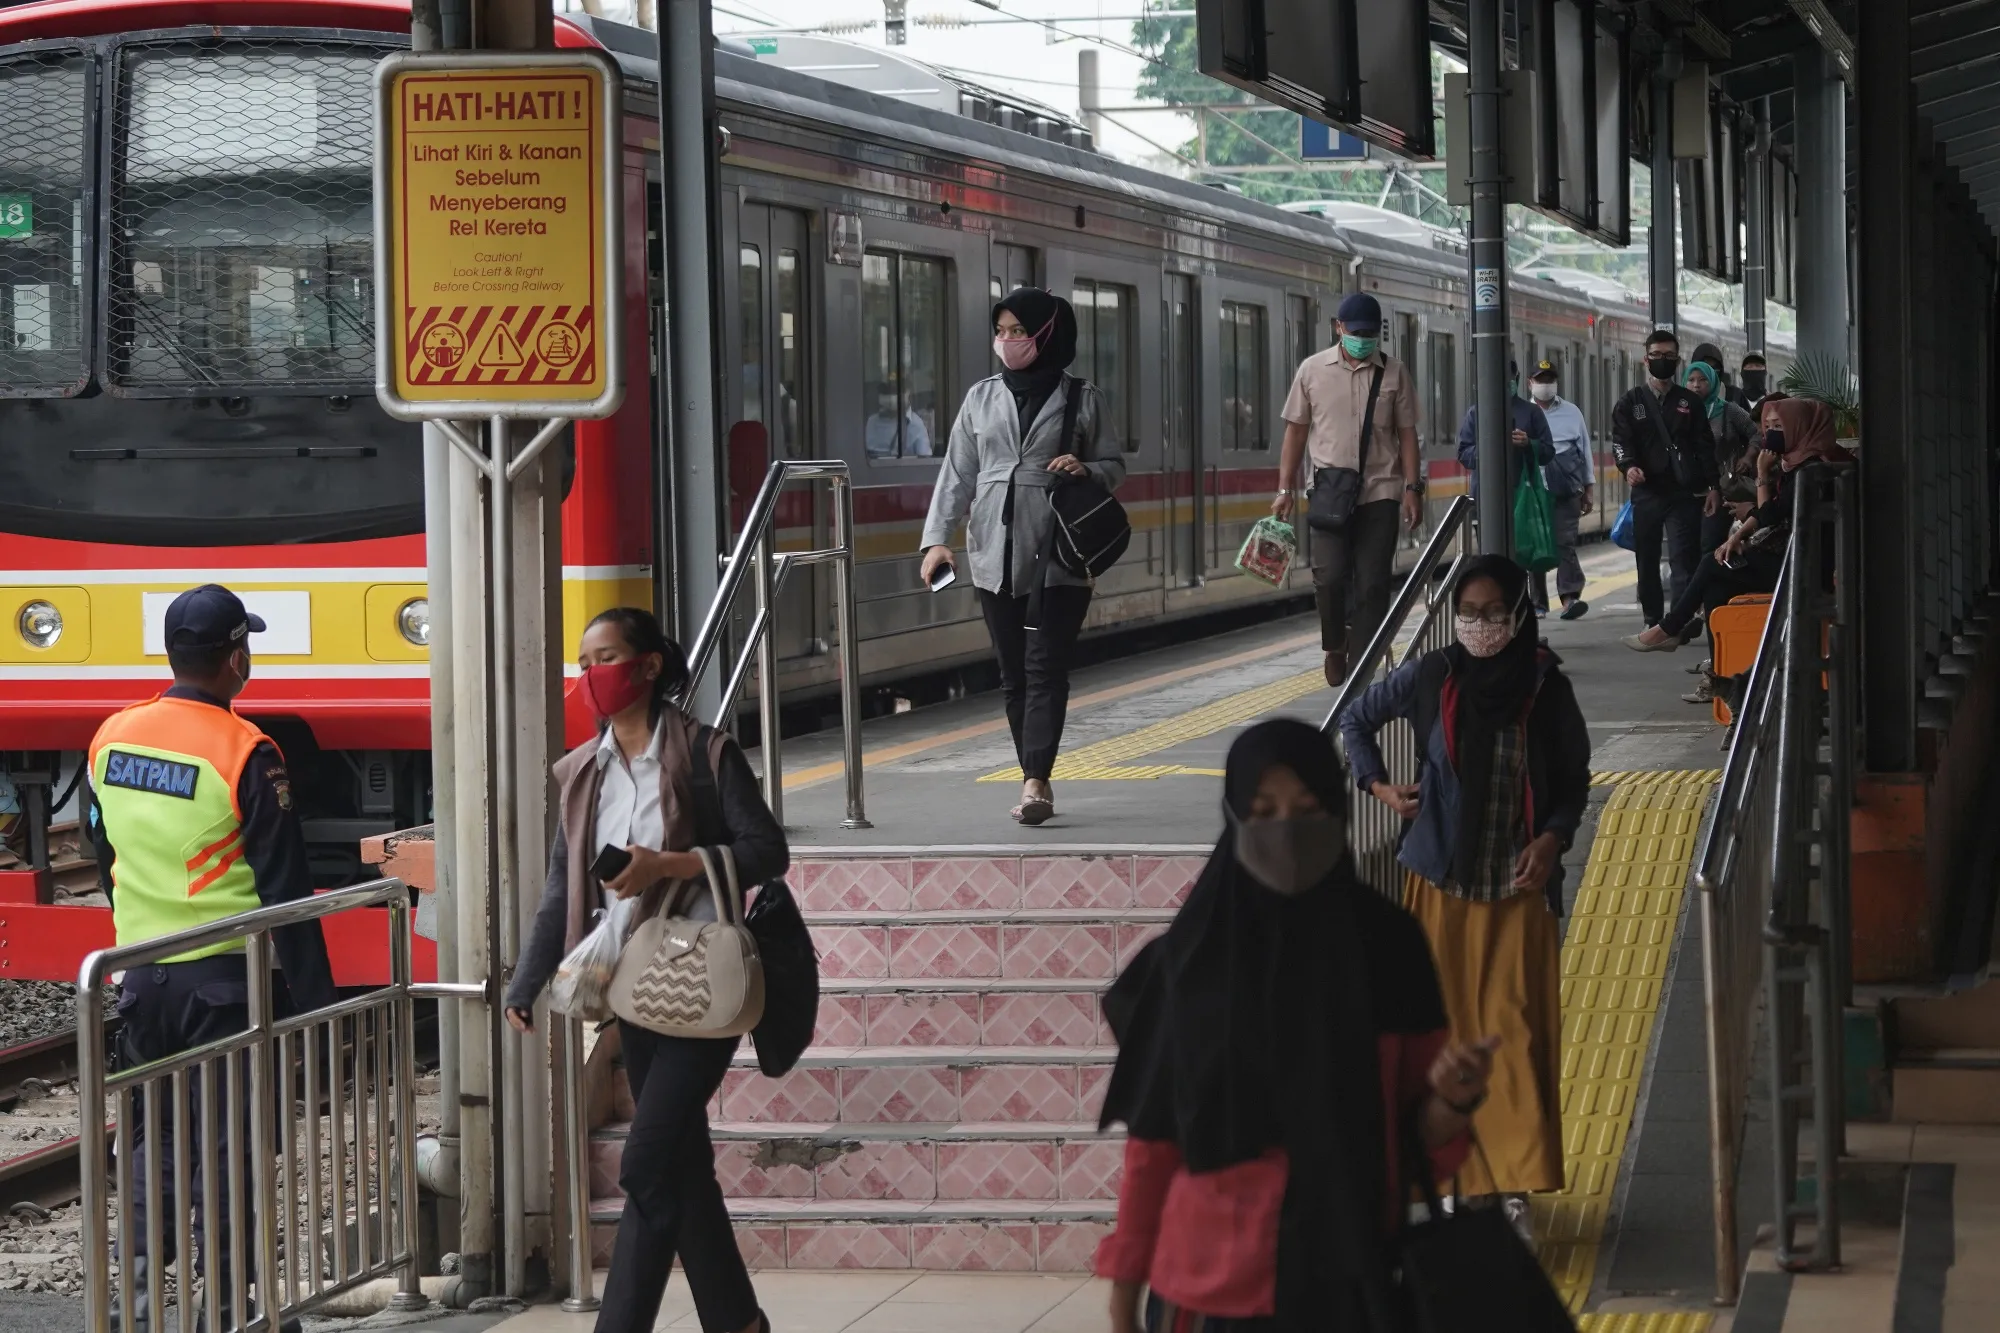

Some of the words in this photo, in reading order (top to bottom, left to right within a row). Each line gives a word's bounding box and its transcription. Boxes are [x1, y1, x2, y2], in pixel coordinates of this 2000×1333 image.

[413, 91, 565, 121] HATI-HATI
[414, 145, 460, 161] Lihat
[466, 144, 493, 161] Kiri
[498, 144, 513, 161] &
[519, 143, 582, 160] Kanan
[455, 169, 540, 186] Sebelum
[430, 194, 567, 214] Menyeberang
[450, 219, 478, 236] Rel
[485, 219, 547, 236] Kereta
[474, 252, 523, 263] Caution!
[453, 267, 479, 277] Look
[481, 267, 502, 277] Left
[504, 268, 513, 277] &
[515, 266, 545, 278] Right
[433, 281, 470, 292] Before
[472, 281, 520, 293] Crossing
[521, 281, 565, 293] Railway
[108, 755, 195, 795] SATPAM
